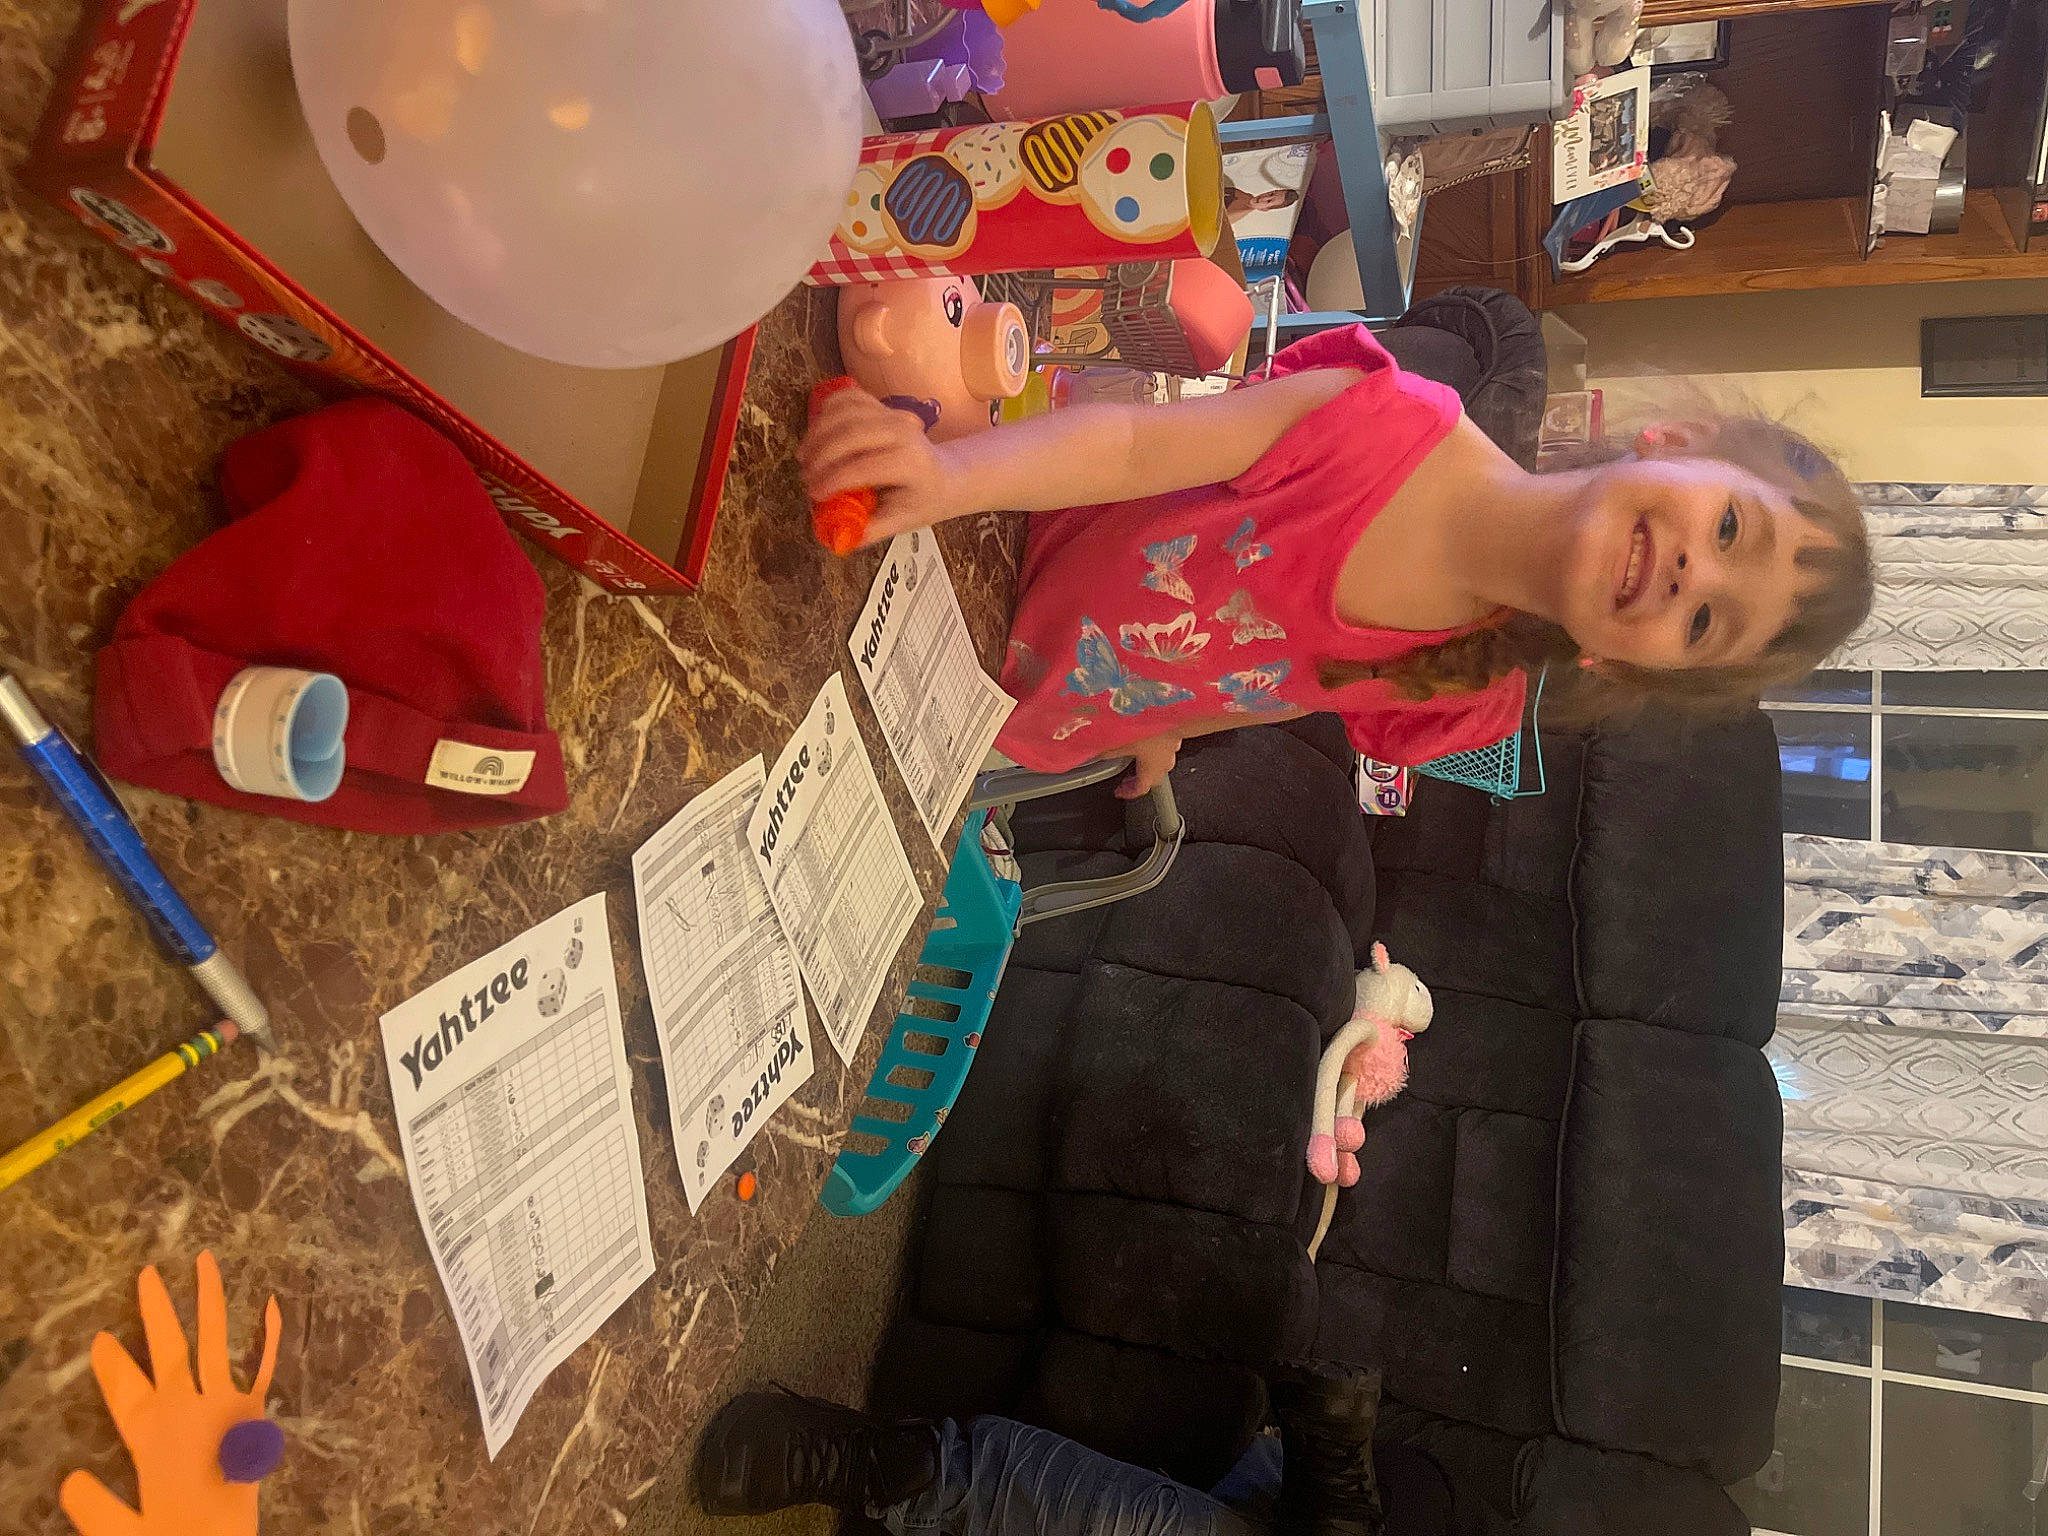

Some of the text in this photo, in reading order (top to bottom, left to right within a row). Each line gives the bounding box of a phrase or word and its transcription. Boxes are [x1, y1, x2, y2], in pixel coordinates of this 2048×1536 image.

[861, 562, 899, 673] Yahtzee
[760, 744, 810, 867] Yahtzee
[400, 957, 528, 1092] Yahtzee
[732, 1027, 804, 1138] Yahtzee
